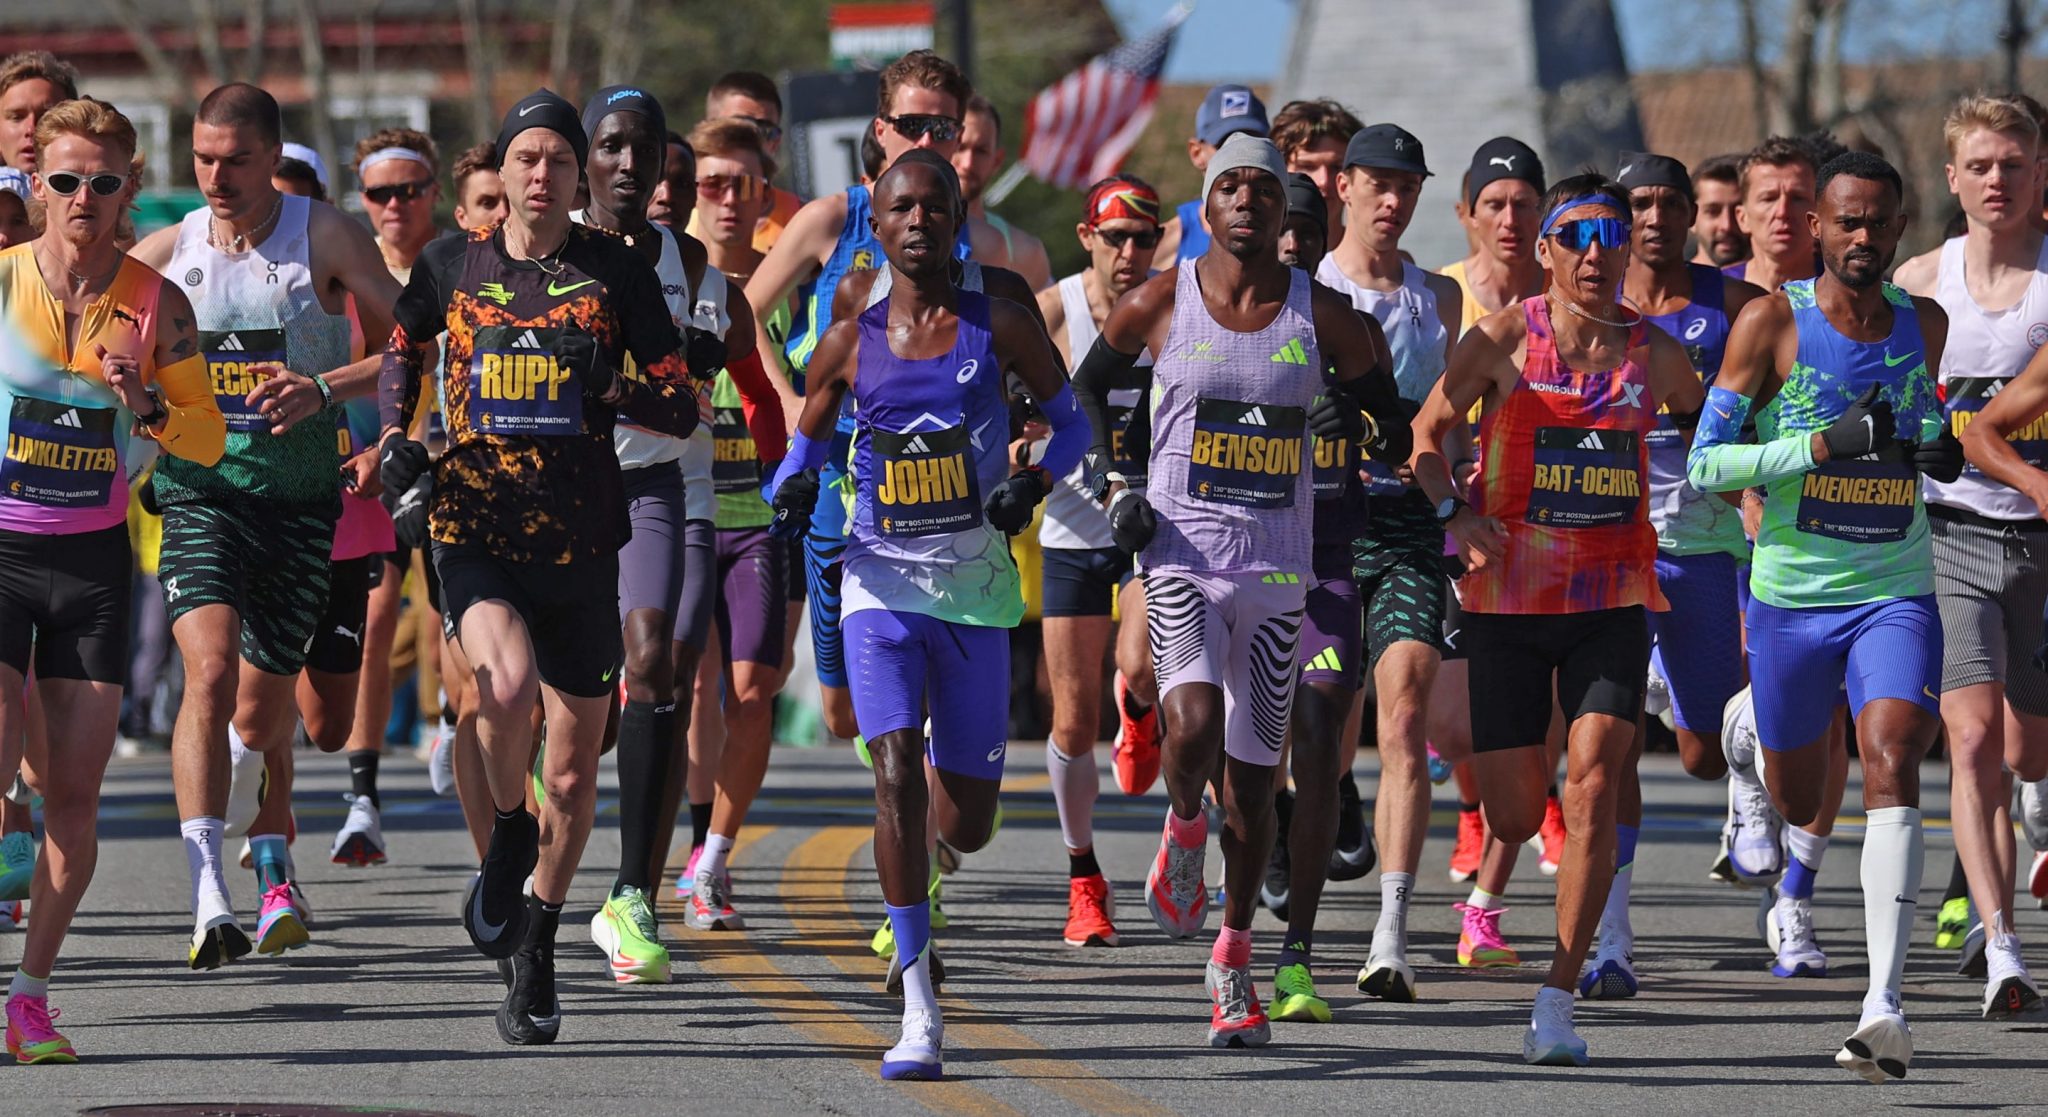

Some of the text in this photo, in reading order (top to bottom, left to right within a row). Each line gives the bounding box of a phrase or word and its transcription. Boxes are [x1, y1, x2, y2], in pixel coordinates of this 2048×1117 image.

[607, 90, 642, 105] HOKA
[481, 353, 571, 401] RUPP
[1529, 382, 1582, 396] MONGOLIA
[508, 416, 533, 424] BOSTON
[534, 416, 571, 424] MARATHON
[6, 433, 118, 472] LINKLETTER
[1191, 429, 1301, 475] BENSON
[878, 453, 969, 505] JOHN
[1533, 463, 1641, 498] BAT-OCHIR
[39, 487, 65, 497] BOSTON
[66, 489, 99, 498] MARATHON
[1227, 487, 1252, 497] BOSTON
[1253, 489, 1285, 499] MARATHON
[1803, 473, 1915, 506] MENGESHA
[909, 518, 935, 527] BOSTON
[936, 513, 972, 524] MARATHON
[1592, 511, 1623, 519] MARATHON
[1838, 525, 1864, 533] BOSTON
